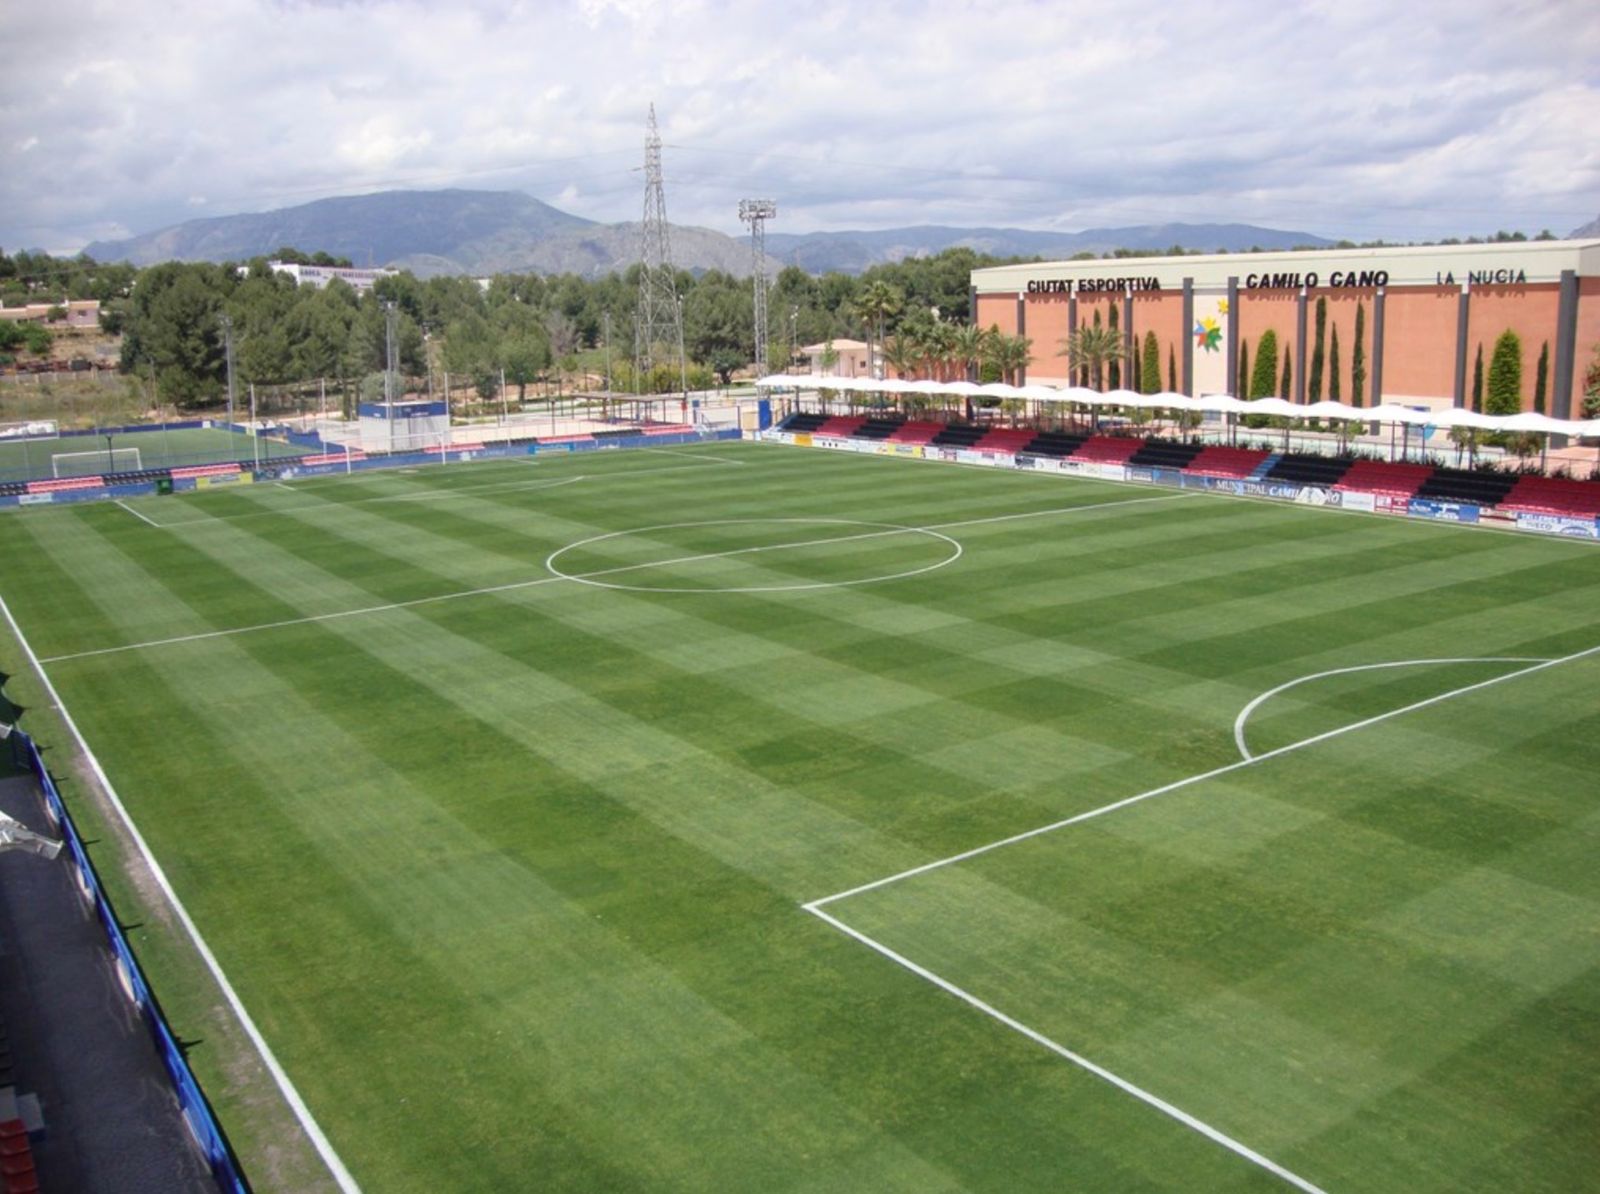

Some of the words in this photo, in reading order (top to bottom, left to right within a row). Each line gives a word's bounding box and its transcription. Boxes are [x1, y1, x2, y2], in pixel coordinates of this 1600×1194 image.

[1027, 279, 1074, 293] CIUTAT
[1078, 277, 1161, 292] ESPORTIVA
[1246, 272, 1319, 289] CAMILO
[1329, 270, 1390, 288] CANO
[1437, 271, 1455, 286] LA
[1468, 269, 1527, 286] NUCIA
